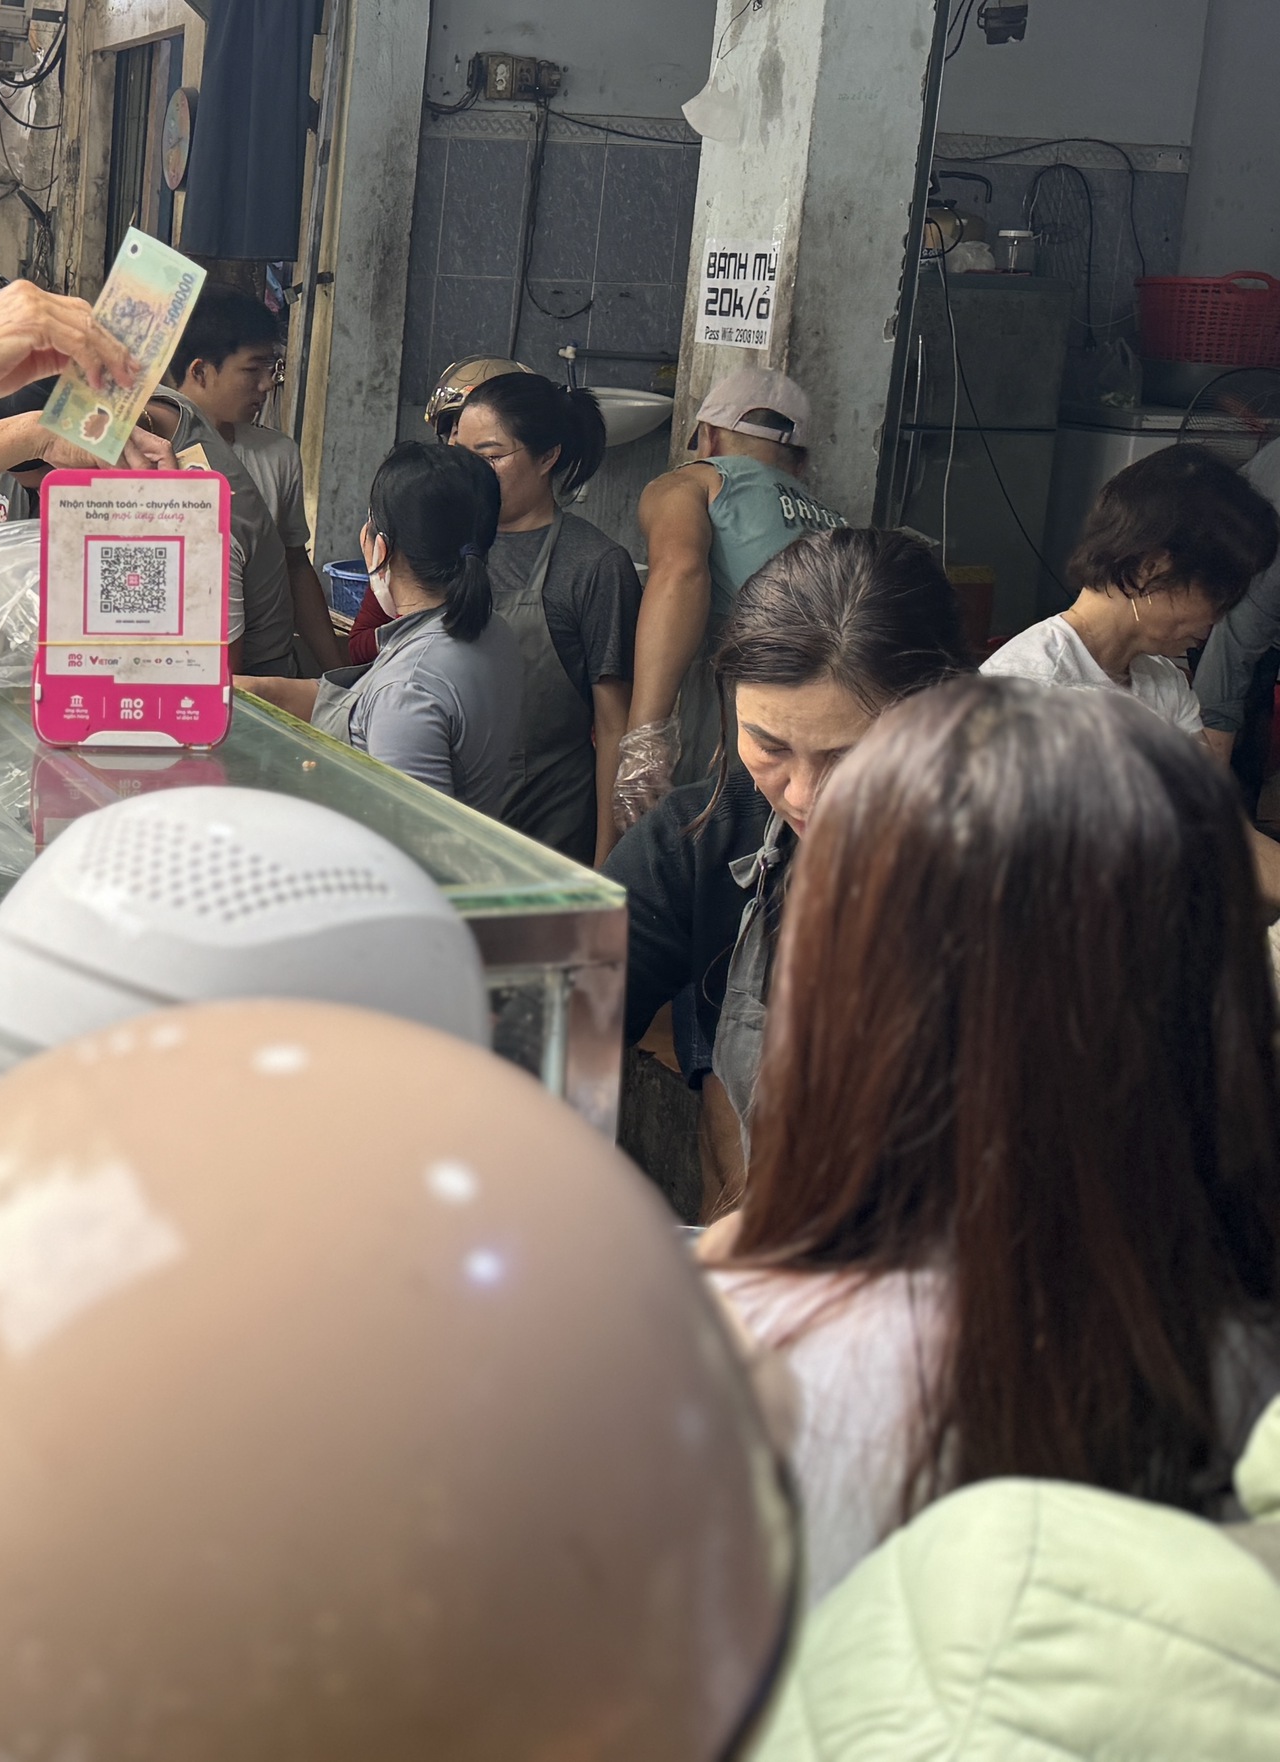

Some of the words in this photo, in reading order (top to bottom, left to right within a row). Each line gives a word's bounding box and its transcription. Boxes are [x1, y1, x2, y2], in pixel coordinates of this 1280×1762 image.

[707, 246, 748, 280] BÁNH
[165, 271, 195, 329] 500000
[59, 499, 84, 510] Nhận
[86, 499, 114, 509] thanh
